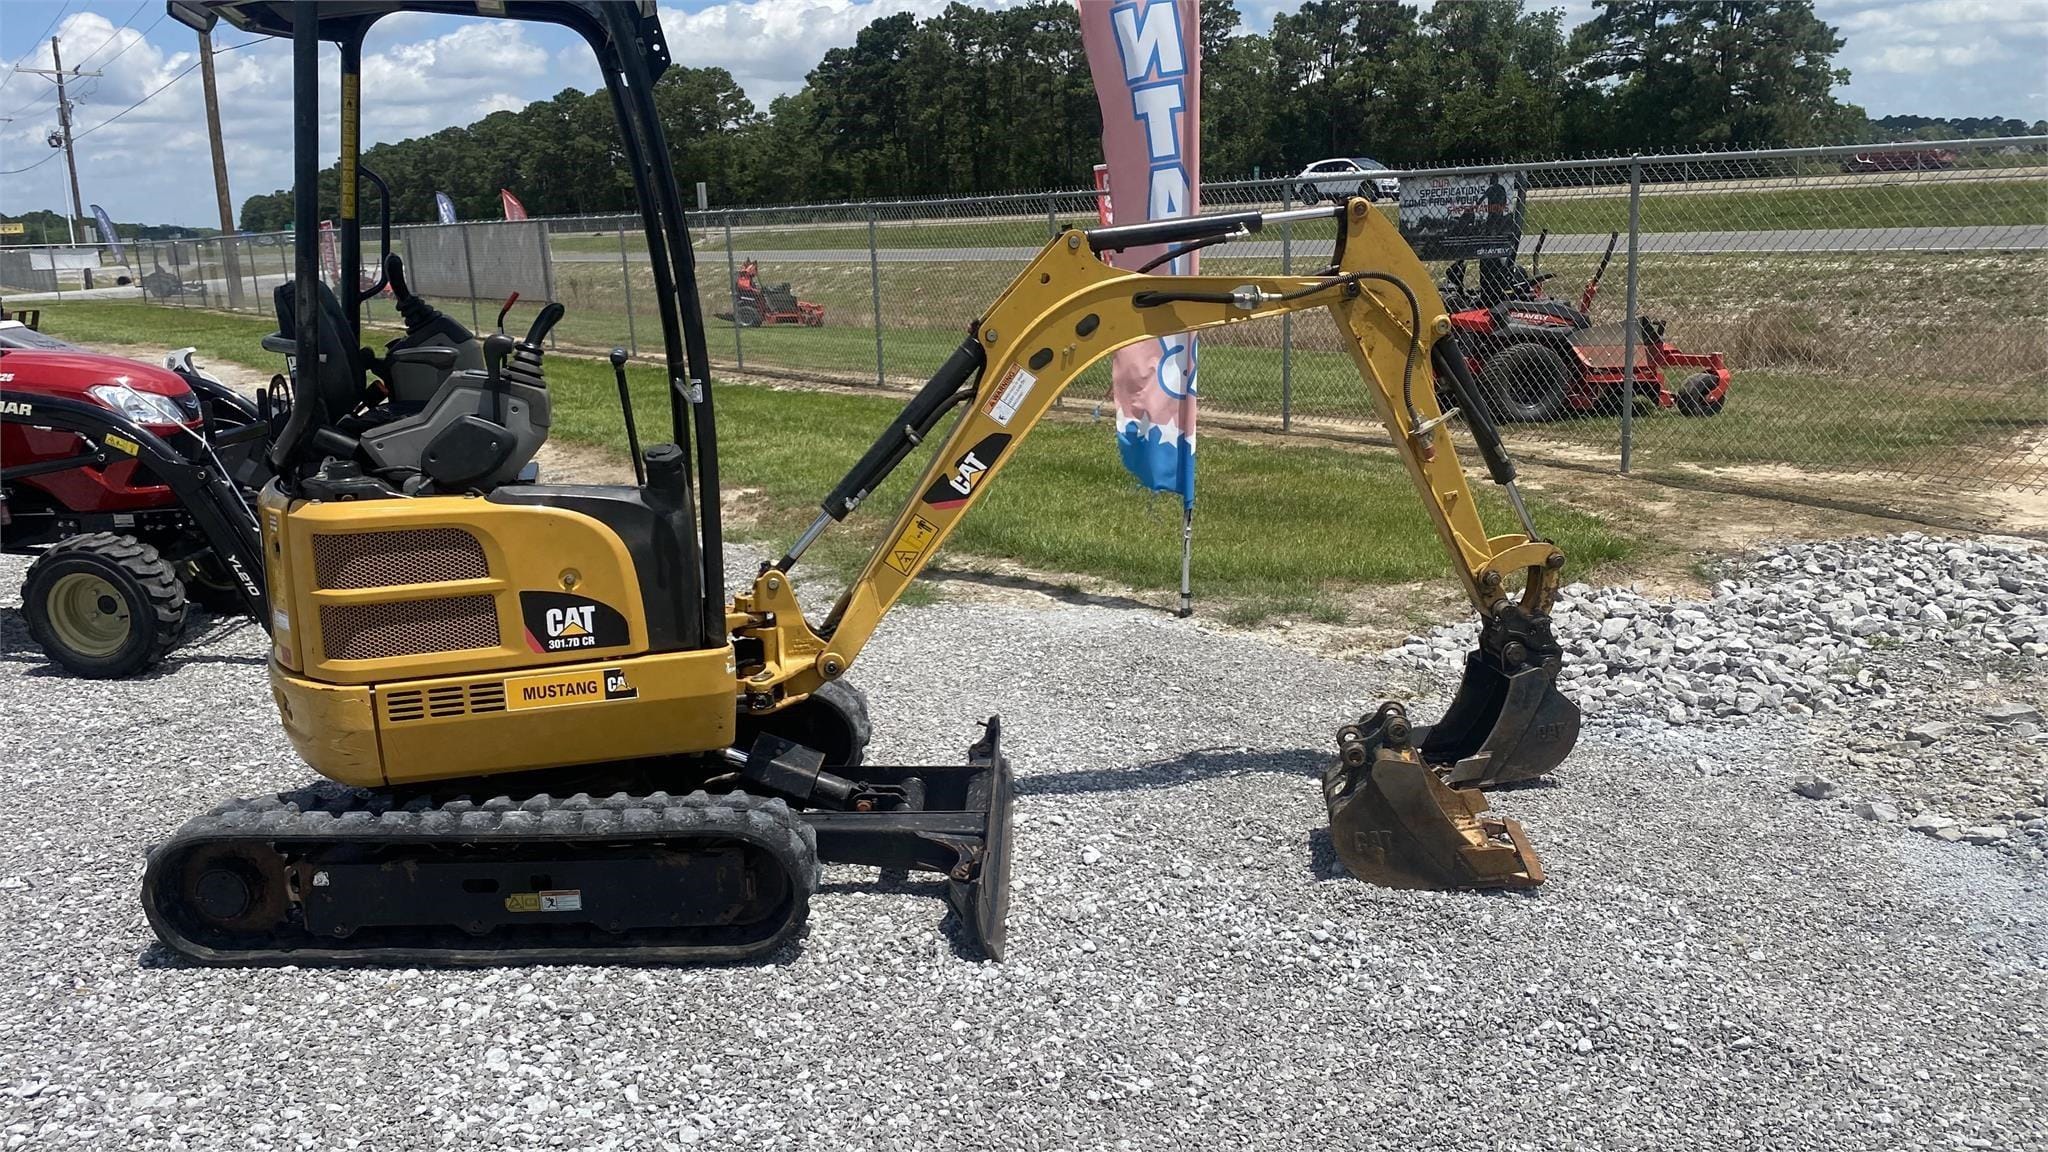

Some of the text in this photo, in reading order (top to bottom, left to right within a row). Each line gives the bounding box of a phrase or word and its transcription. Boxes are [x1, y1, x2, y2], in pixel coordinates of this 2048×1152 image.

[1420, 186, 1486, 198] SPECIFICATIONS
[1432, 179, 1449, 188] OUR
[1404, 195, 1479, 208] COME FROM YOUR
[1511, 311, 1549, 321] GRAVELY
[993, 371, 1015, 402] WARNING
[949, 451, 988, 495] CAT
[228, 554, 260, 596] YL210
[546, 605, 596, 637] CAT
[548, 636, 595, 650] 301.7D CR
[523, 680, 598, 701] MUSTANG
